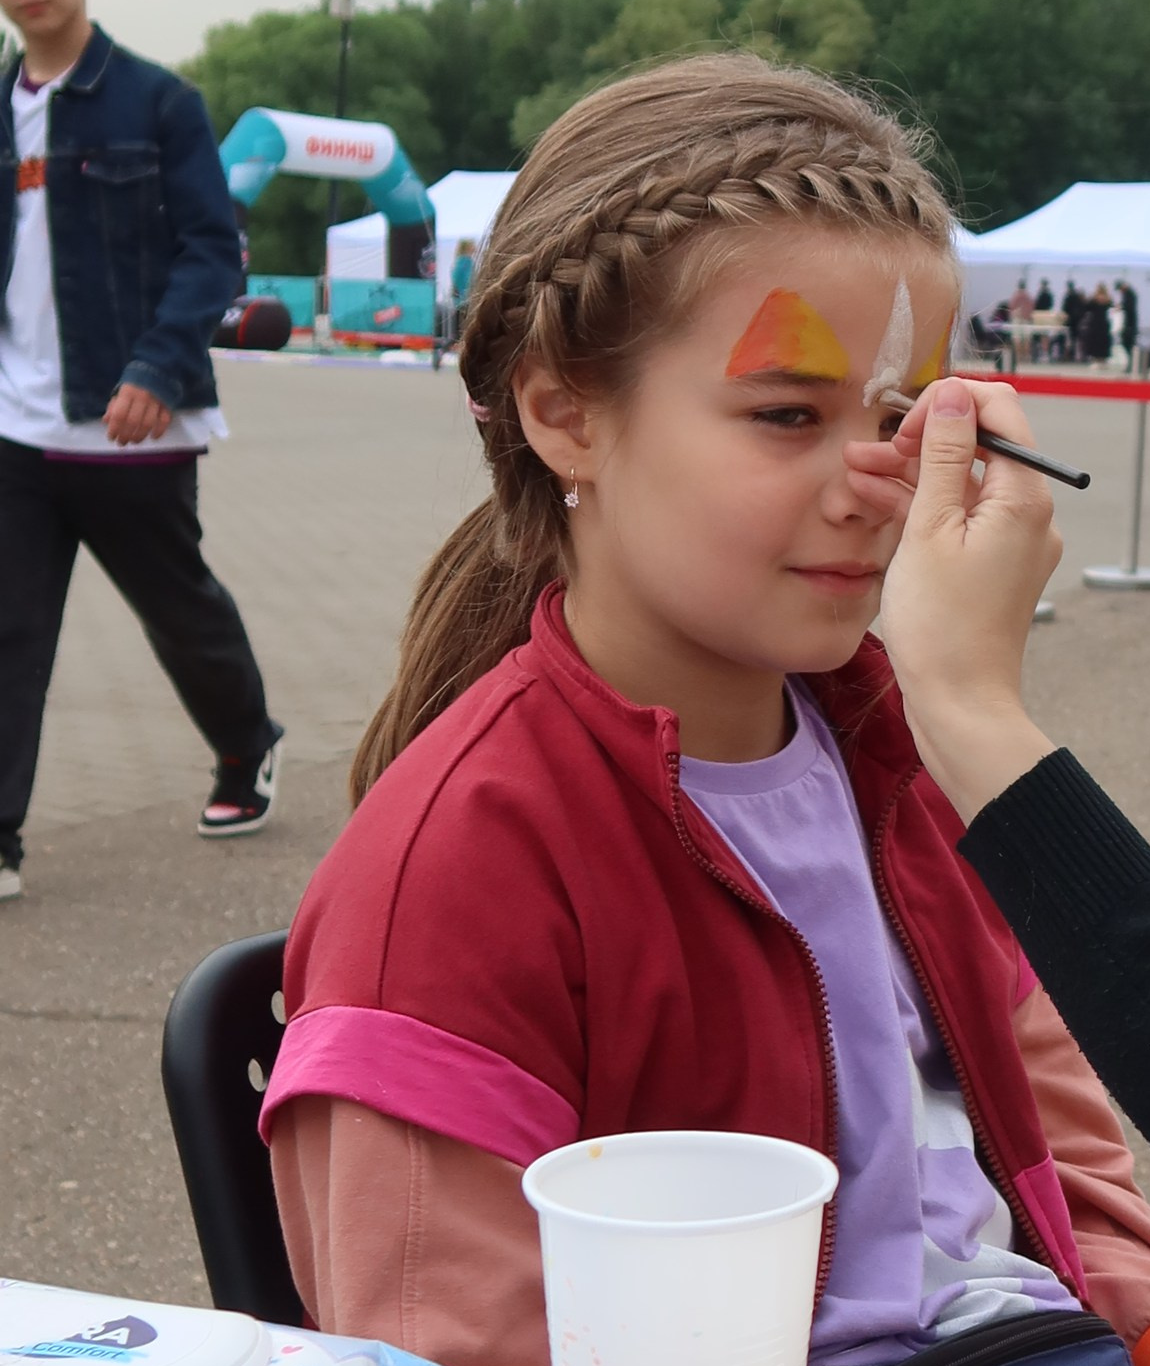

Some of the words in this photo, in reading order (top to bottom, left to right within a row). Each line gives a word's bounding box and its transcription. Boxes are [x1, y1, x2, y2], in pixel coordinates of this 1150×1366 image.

[306, 136, 375, 163] ФИНИШ
[80, 1323, 131, 1346] RA
[32, 1341, 126, 1360] Comfort
